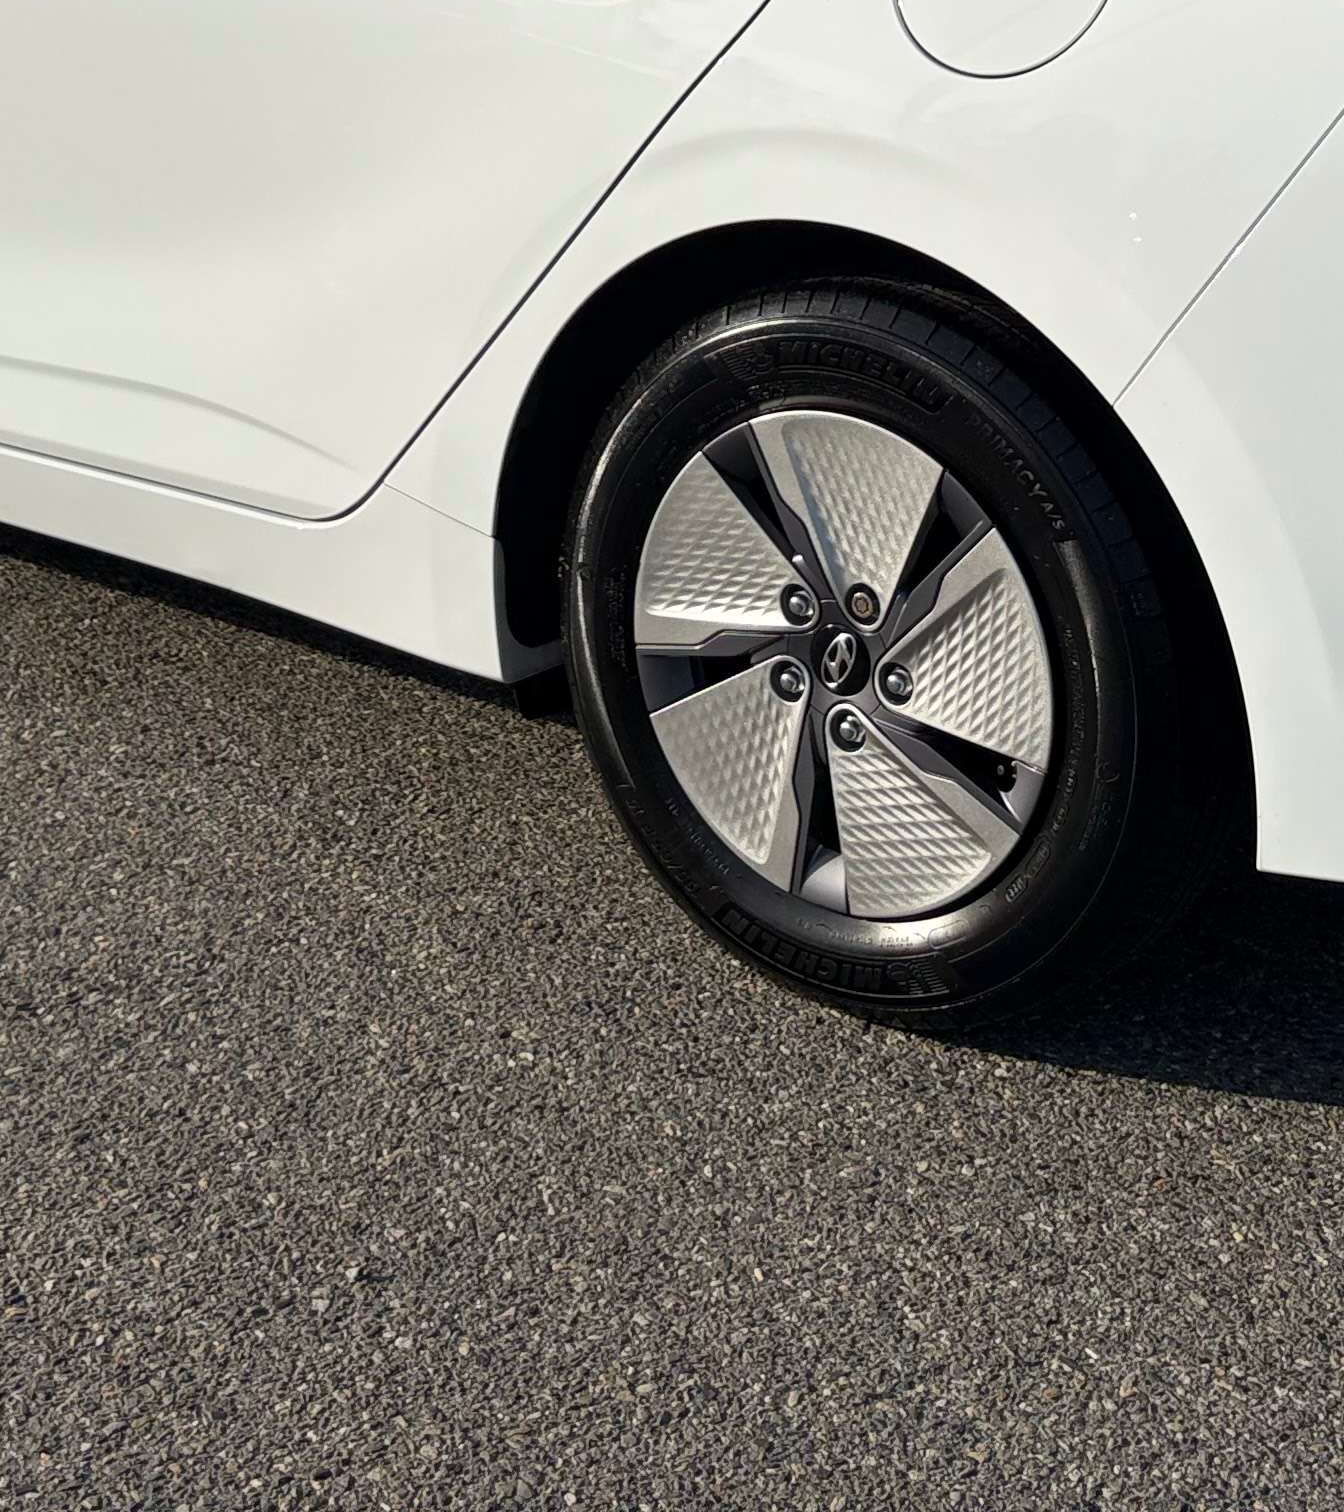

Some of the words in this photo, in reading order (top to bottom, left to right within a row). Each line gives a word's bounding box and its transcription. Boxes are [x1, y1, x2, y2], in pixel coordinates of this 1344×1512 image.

[778, 339, 942, 410] MICHELIN
[1040, 502, 1067, 530] A/S
[721, 908, 883, 992] MICHELIN
